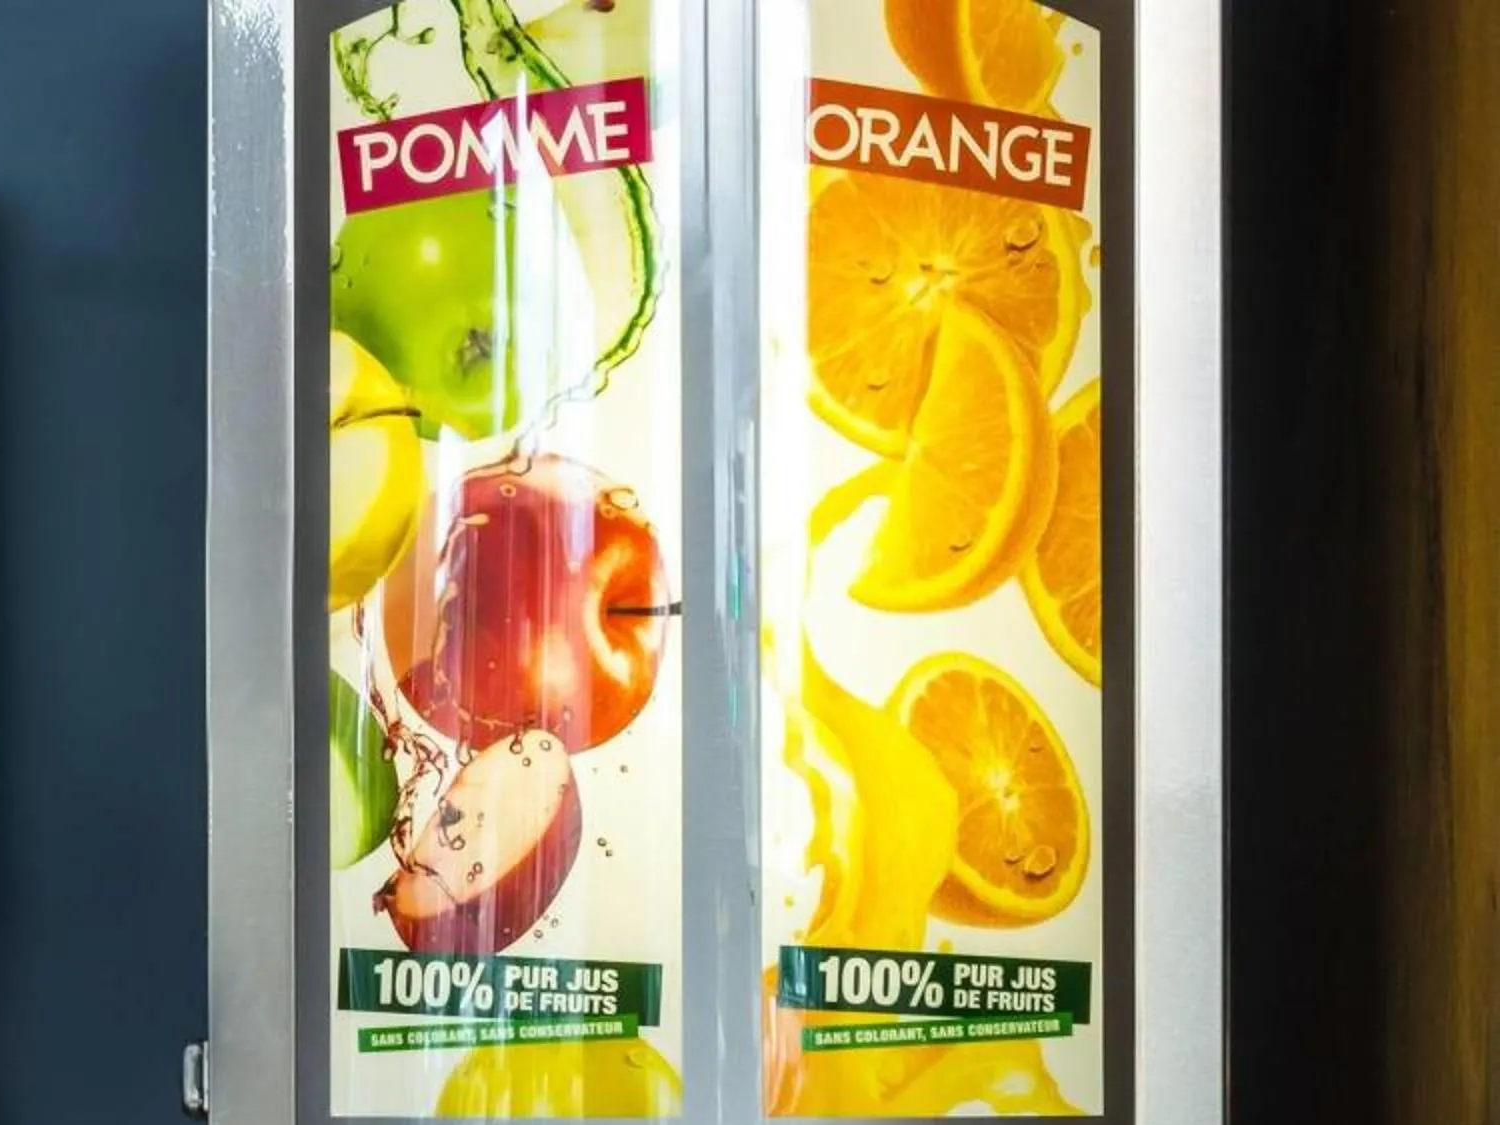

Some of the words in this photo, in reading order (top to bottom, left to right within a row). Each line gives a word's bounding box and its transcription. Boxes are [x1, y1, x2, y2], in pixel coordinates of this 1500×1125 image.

[353, 101, 631, 193] POMME
[805, 103, 1075, 187] ORANGE
[373, 957, 494, 1010] 100%
[504, 965, 558, 991] PUR
[567, 968, 619, 993] JUS
[818, 955, 944, 1009] 100%
[953, 962, 1004, 988] PUR
[1011, 966, 1057, 991] JUS
[506, 991, 534, 1011] DE
[539, 992, 617, 1015] FRUITS
[953, 989, 981, 1010] DE
[987, 991, 1056, 1013] FRUITS
[371, 1032, 404, 1047] SANS
[480, 1026, 514, 1041] SANS
[519, 1021, 623, 1038] CONSERVATEUR
[815, 1031, 850, 1046] SANS
[930, 1025, 964, 1039] SANS
[968, 1019, 1061, 1037] CONSERVATEUR
